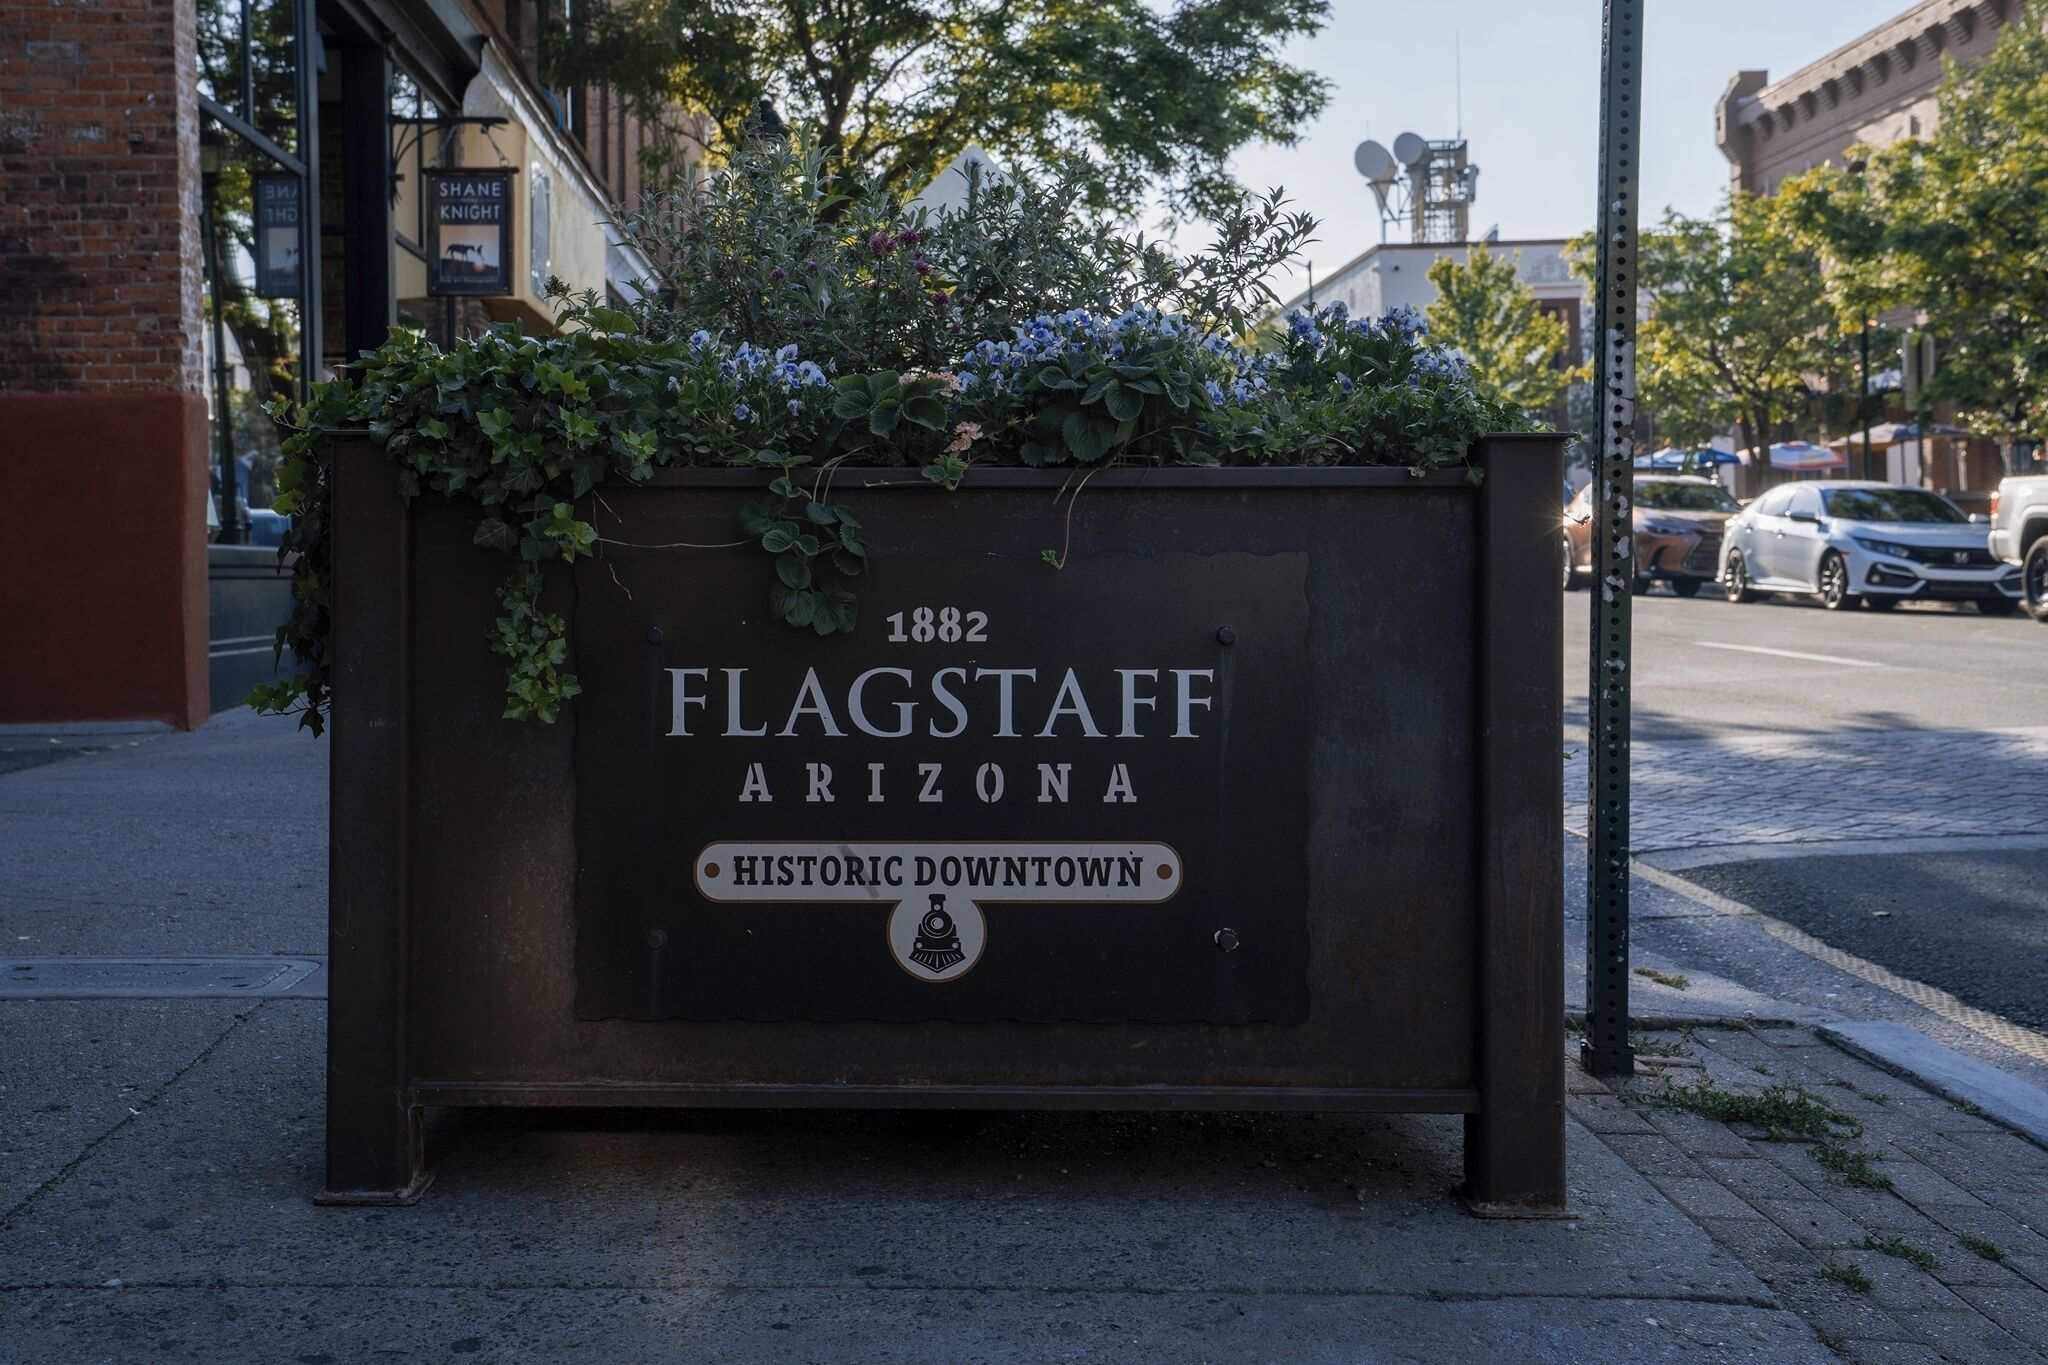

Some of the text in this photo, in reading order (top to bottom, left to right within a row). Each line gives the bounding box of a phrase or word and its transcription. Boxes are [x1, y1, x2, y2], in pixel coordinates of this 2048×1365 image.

[439, 181, 501, 198] SHANE
[439, 204, 501, 220] KNIGHT
[886, 606, 988, 643] 1882
[664, 666, 1215, 738] FLAGSTAFF
[738, 762, 1138, 803] ARIZONA
[733, 855, 1143, 887] HISTORIC DOWNTOWN
